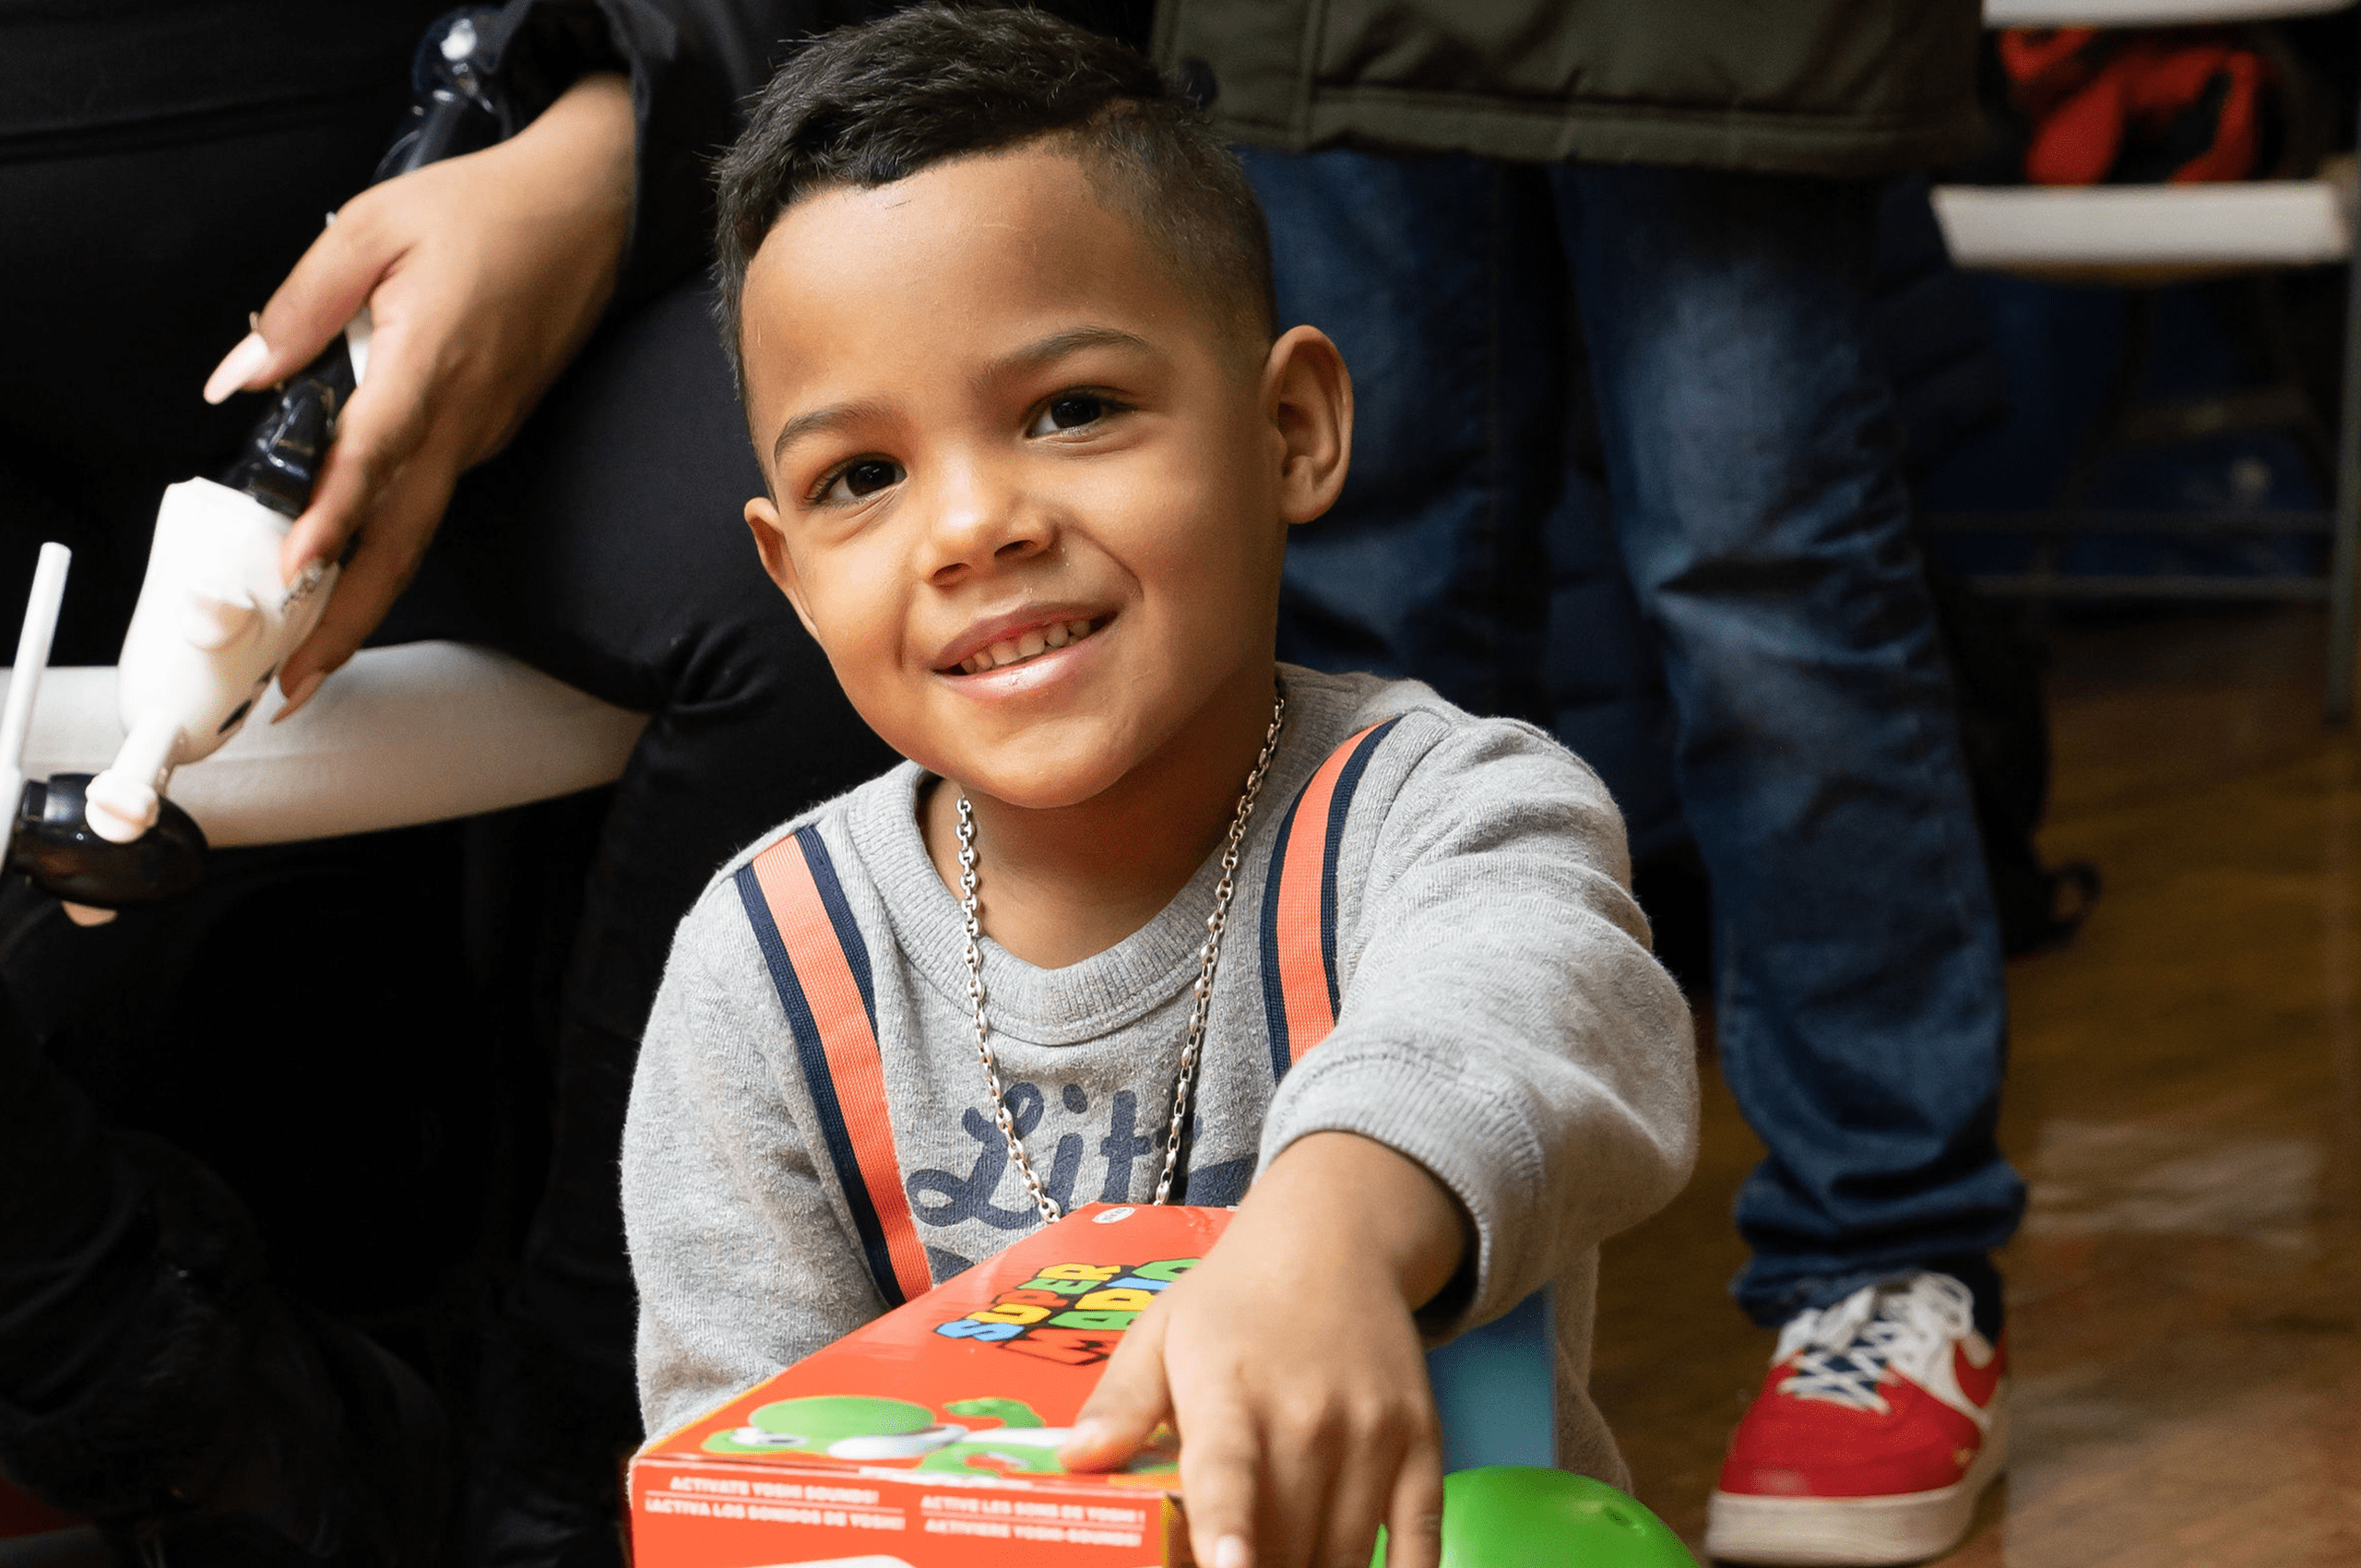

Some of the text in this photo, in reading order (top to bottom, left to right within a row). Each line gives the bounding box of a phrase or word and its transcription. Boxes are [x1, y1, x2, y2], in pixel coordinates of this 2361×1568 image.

[933, 1261, 1121, 1344] SUPER
[670, 1475, 879, 1505] ACTIVATE YOSHI SOUNDS!
[712, 1502, 745, 1520] LOS
[747, 1504, 821, 1526] SONIDOS
[823, 1509, 847, 1527] DE
[920, 1494, 979, 1514] ACTIVE
[981, 1499, 1011, 1516] LES
[1060, 1503, 1083, 1520] DE
